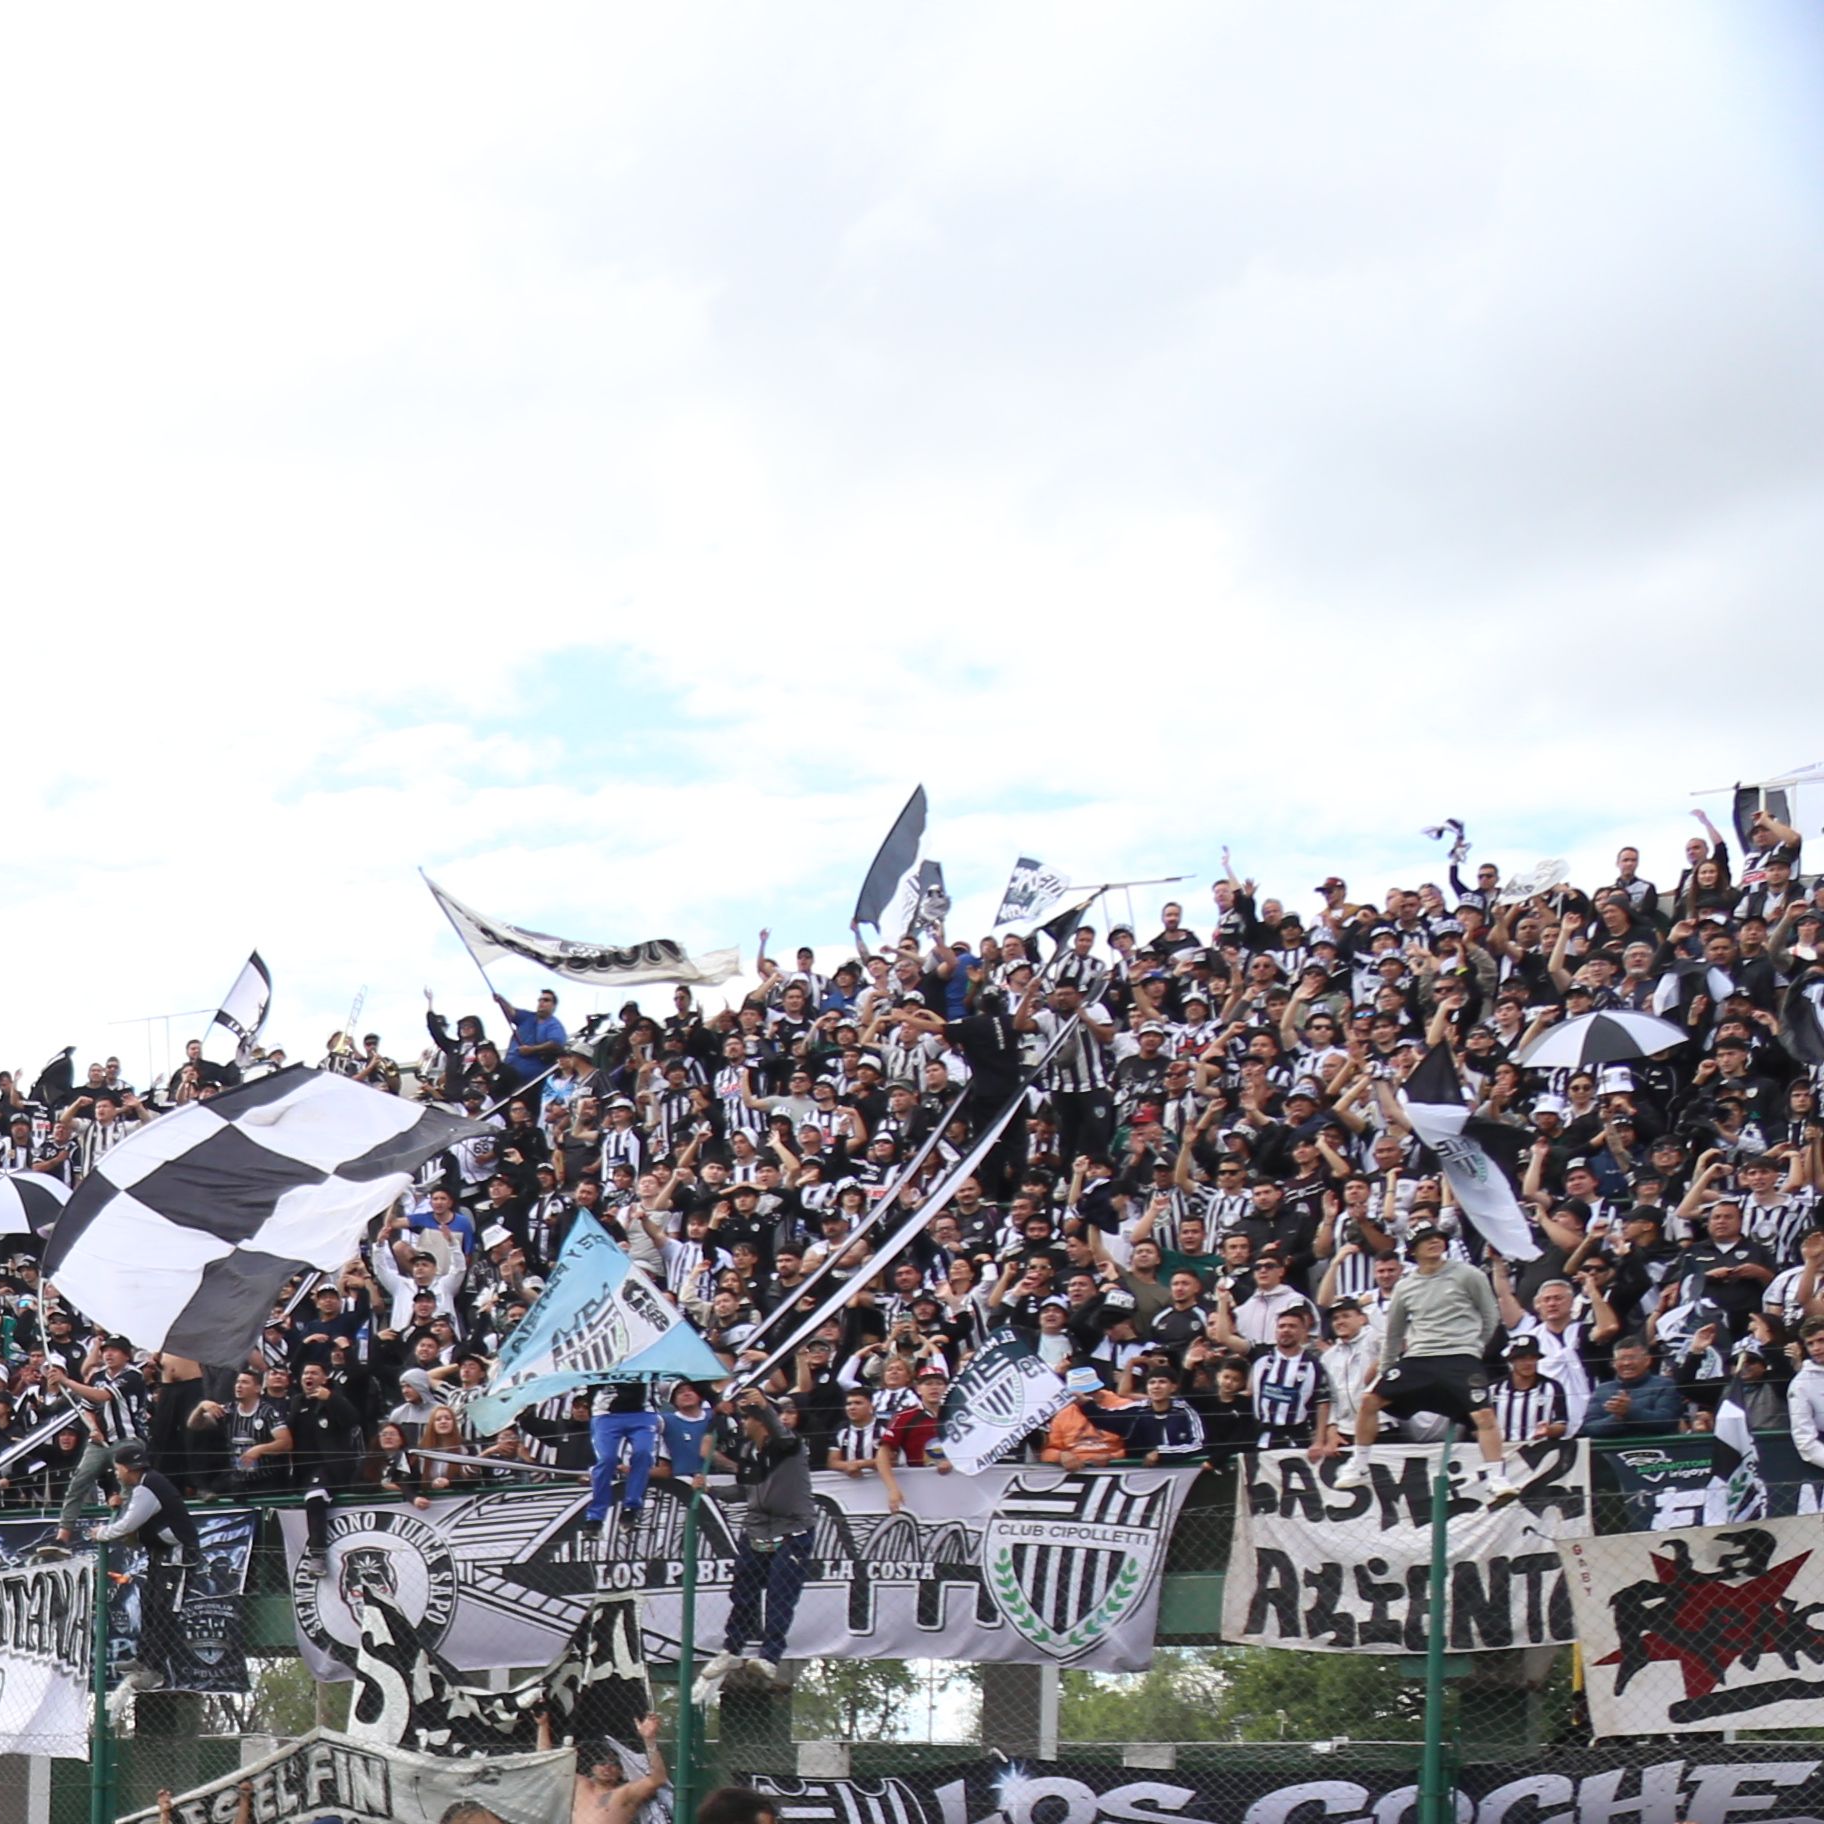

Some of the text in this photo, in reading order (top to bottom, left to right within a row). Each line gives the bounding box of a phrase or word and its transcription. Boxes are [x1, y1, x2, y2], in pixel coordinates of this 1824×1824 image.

[997, 1523, 1150, 1547] CLUB CIPOLLETTI
[386, 1514, 448, 1566] NUNCA
[424, 1570, 453, 1625] SAPO
[665, 1560, 735, 1585] PBE
[866, 1561, 935, 1580] COSTA
